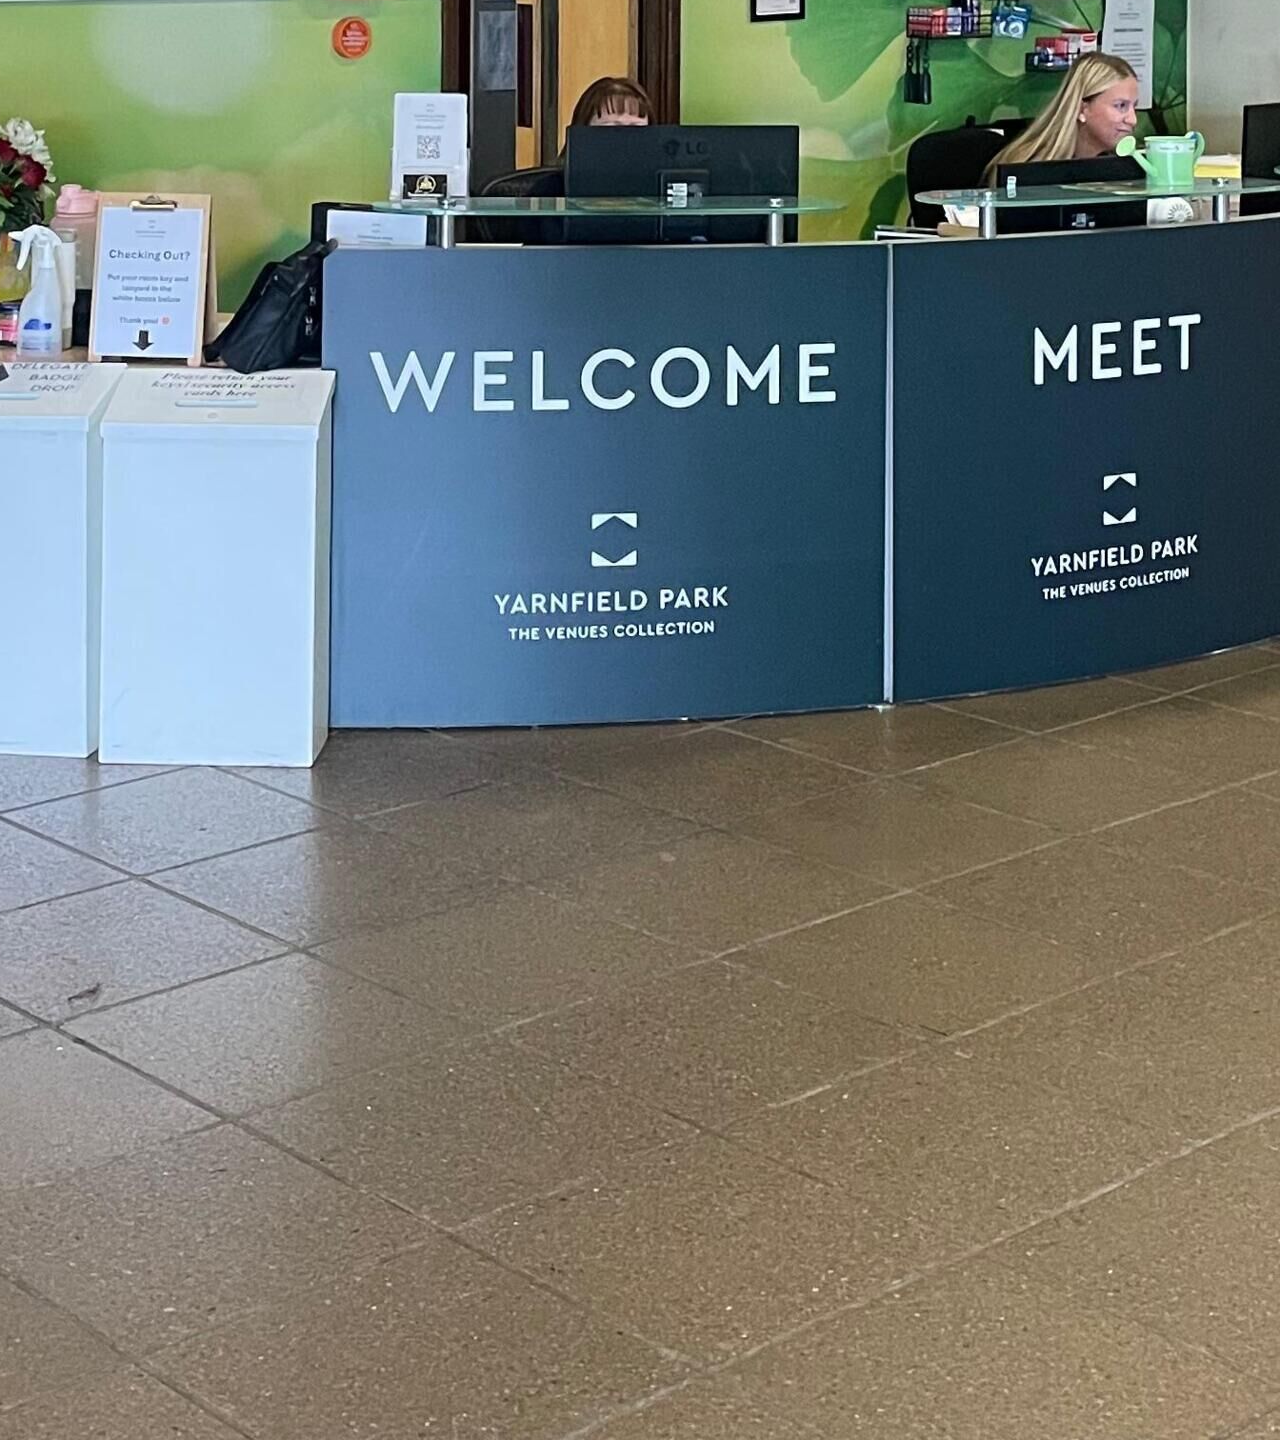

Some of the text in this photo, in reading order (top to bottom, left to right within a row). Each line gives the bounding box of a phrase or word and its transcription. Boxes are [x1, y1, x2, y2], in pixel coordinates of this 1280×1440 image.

[685, 142, 708, 155] LG
[109, 249, 191, 262] Checking Out?
[1033, 313, 1202, 386] MEET
[29, 373, 83, 381] BADGE
[30, 384, 77, 392] DROP
[369, 342, 837, 414] WELCOME
[1031, 534, 1199, 578] YARNFIELD PARK
[1042, 567, 1190, 601] THE VENUES COLLECTION
[494, 586, 729, 615] YARNFIELD PARK
[508, 620, 715, 640] THE VENUES COLLECTION
